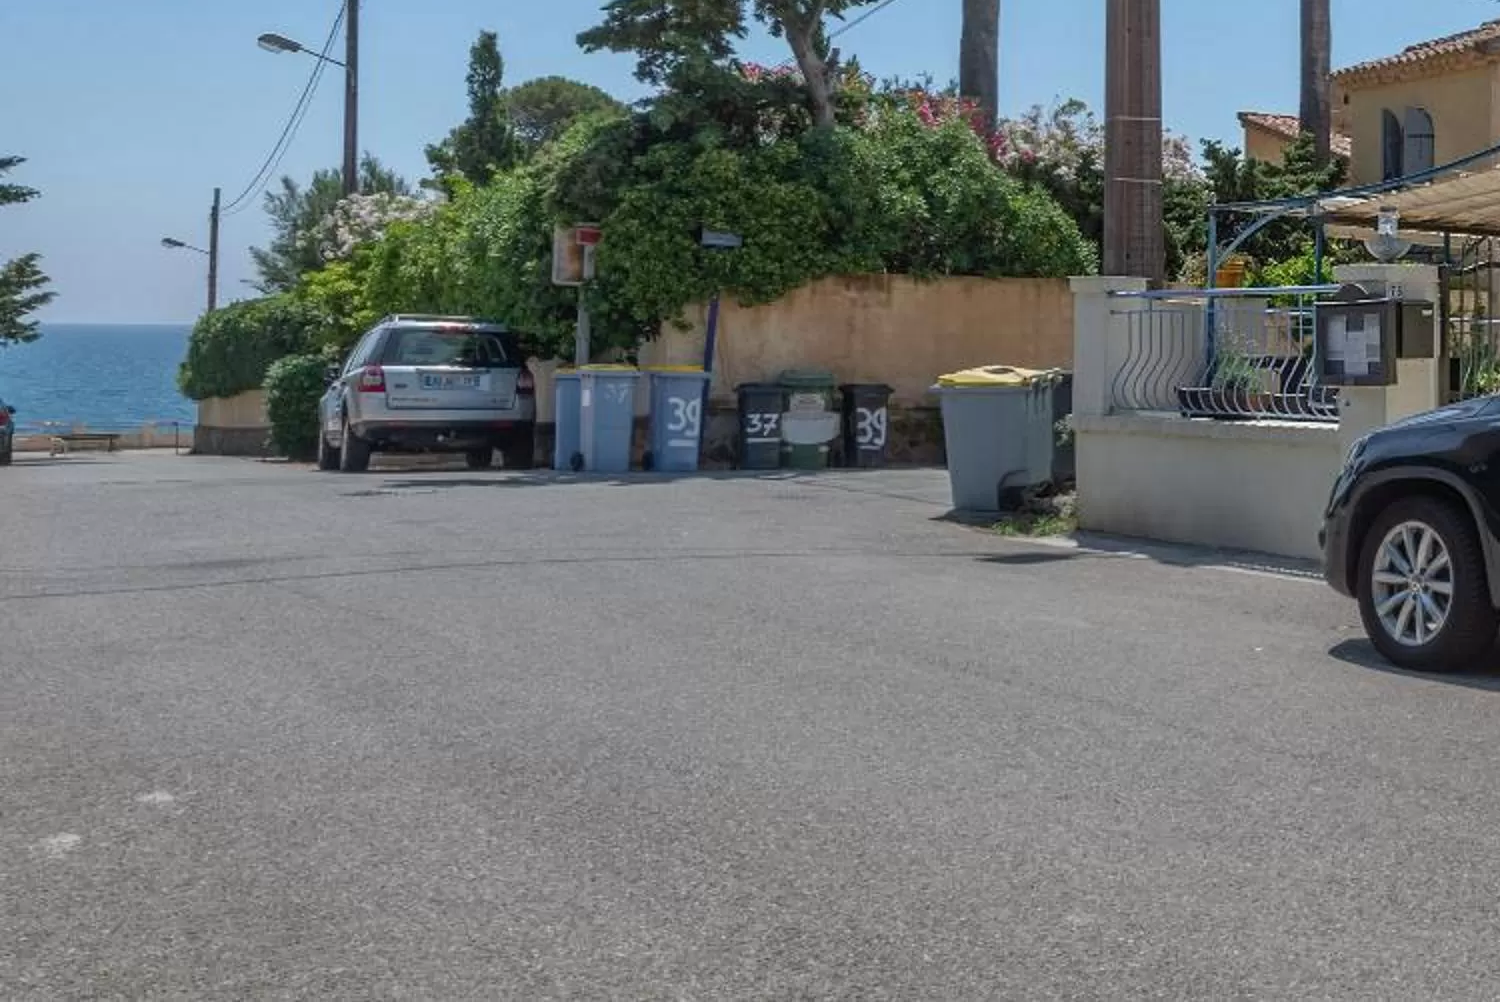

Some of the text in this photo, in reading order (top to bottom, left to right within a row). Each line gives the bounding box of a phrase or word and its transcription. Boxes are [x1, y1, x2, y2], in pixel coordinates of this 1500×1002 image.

[667, 396, 701, 437] 39
[746, 413, 779, 436] 37
[856, 406, 888, 446] 39
